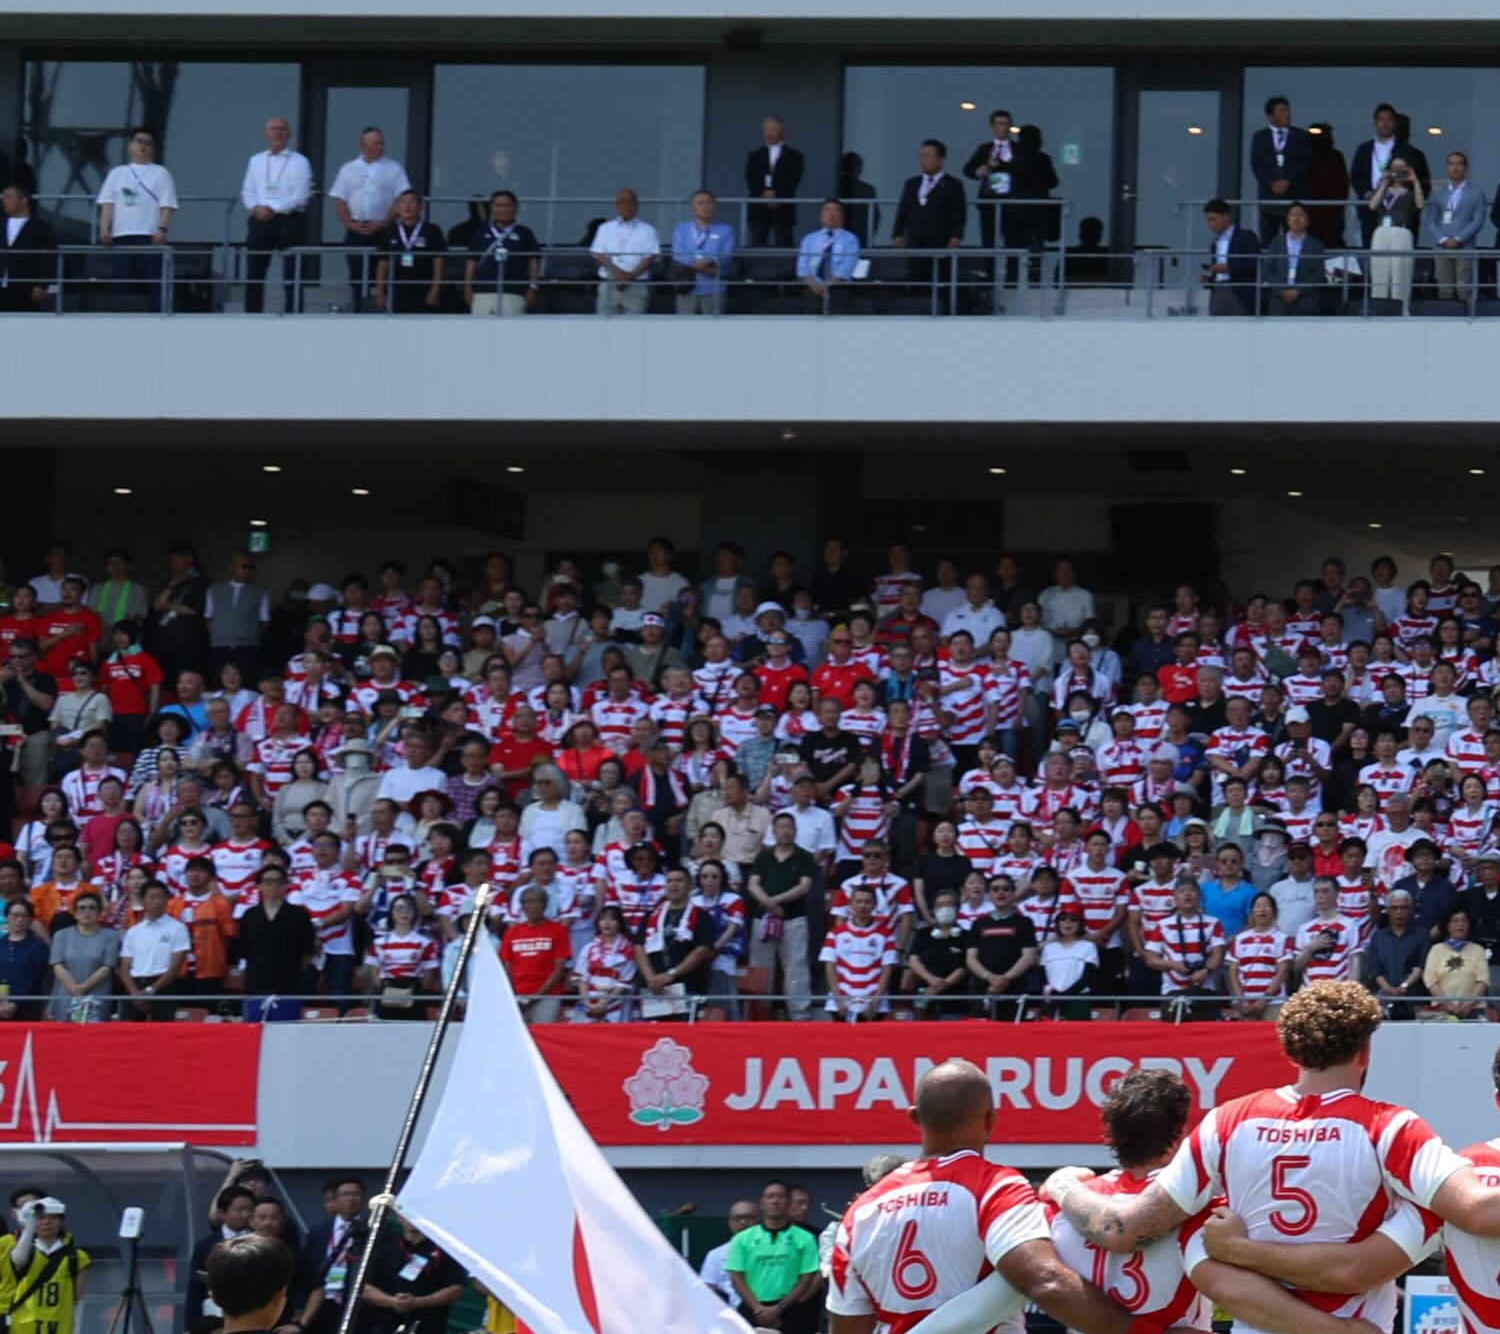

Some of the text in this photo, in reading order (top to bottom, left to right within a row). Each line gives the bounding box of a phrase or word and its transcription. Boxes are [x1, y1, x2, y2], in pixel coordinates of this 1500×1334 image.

[984, 1057, 1234, 1111] RUGY
[1257, 1126, 1342, 1145] TOSHIBA
[878, 1191, 949, 1215] TOSHIBA
[1268, 1155, 1317, 1236] 5
[893, 1220, 937, 1300] 6
[1087, 1243, 1151, 1308] 13
[36, 1281, 60, 1308] 18
